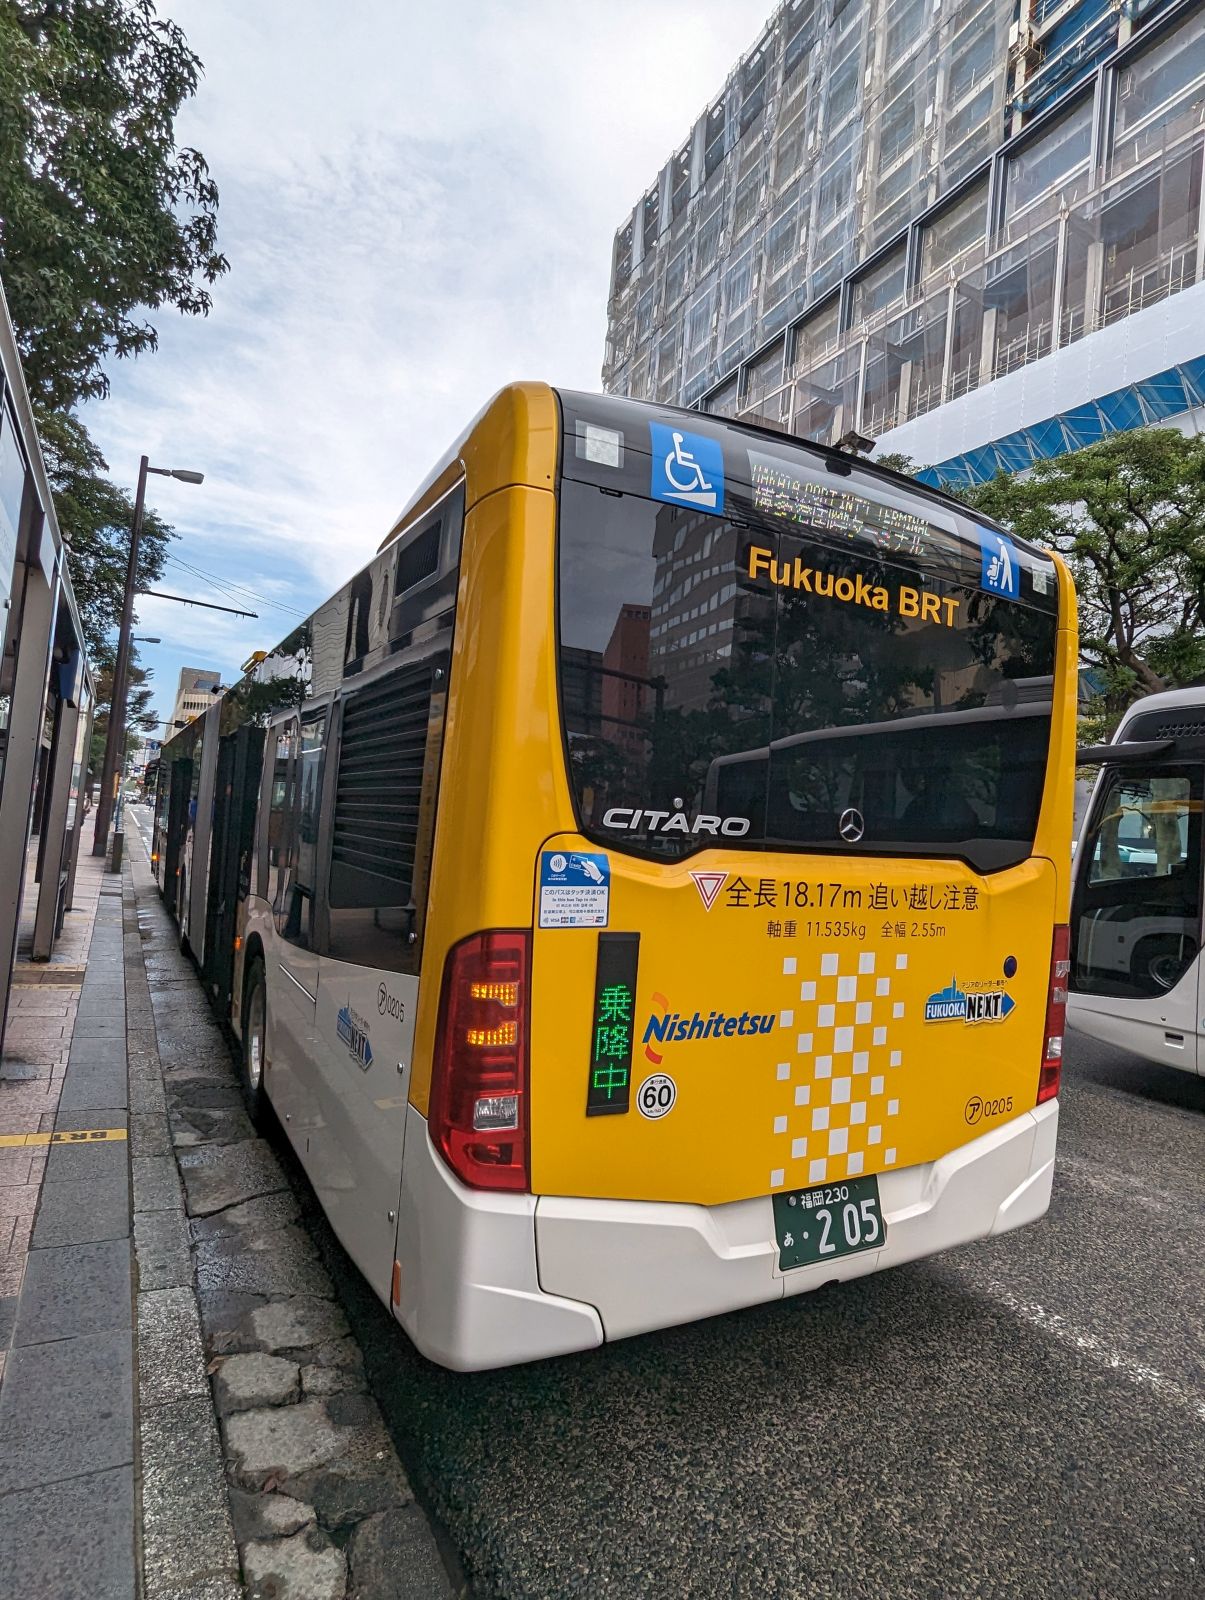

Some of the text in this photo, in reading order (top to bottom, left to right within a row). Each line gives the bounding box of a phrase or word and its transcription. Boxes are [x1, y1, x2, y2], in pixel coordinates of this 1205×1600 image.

[749, 546, 960, 627] Fukuoka BRT
[602, 808, 751, 836] CITARO
[766, 920, 798, 938] 軸重
[807, 922, 866, 940] 11.535kg
[926, 992, 1001, 1020] FUKUOKA NEXT
[642, 1011, 776, 1043] Nishitetsu
[594, 985, 632, 1098] 乗降中
[643, 1085, 672, 1109] 60
[54, 1131, 107, 1141] BRT
